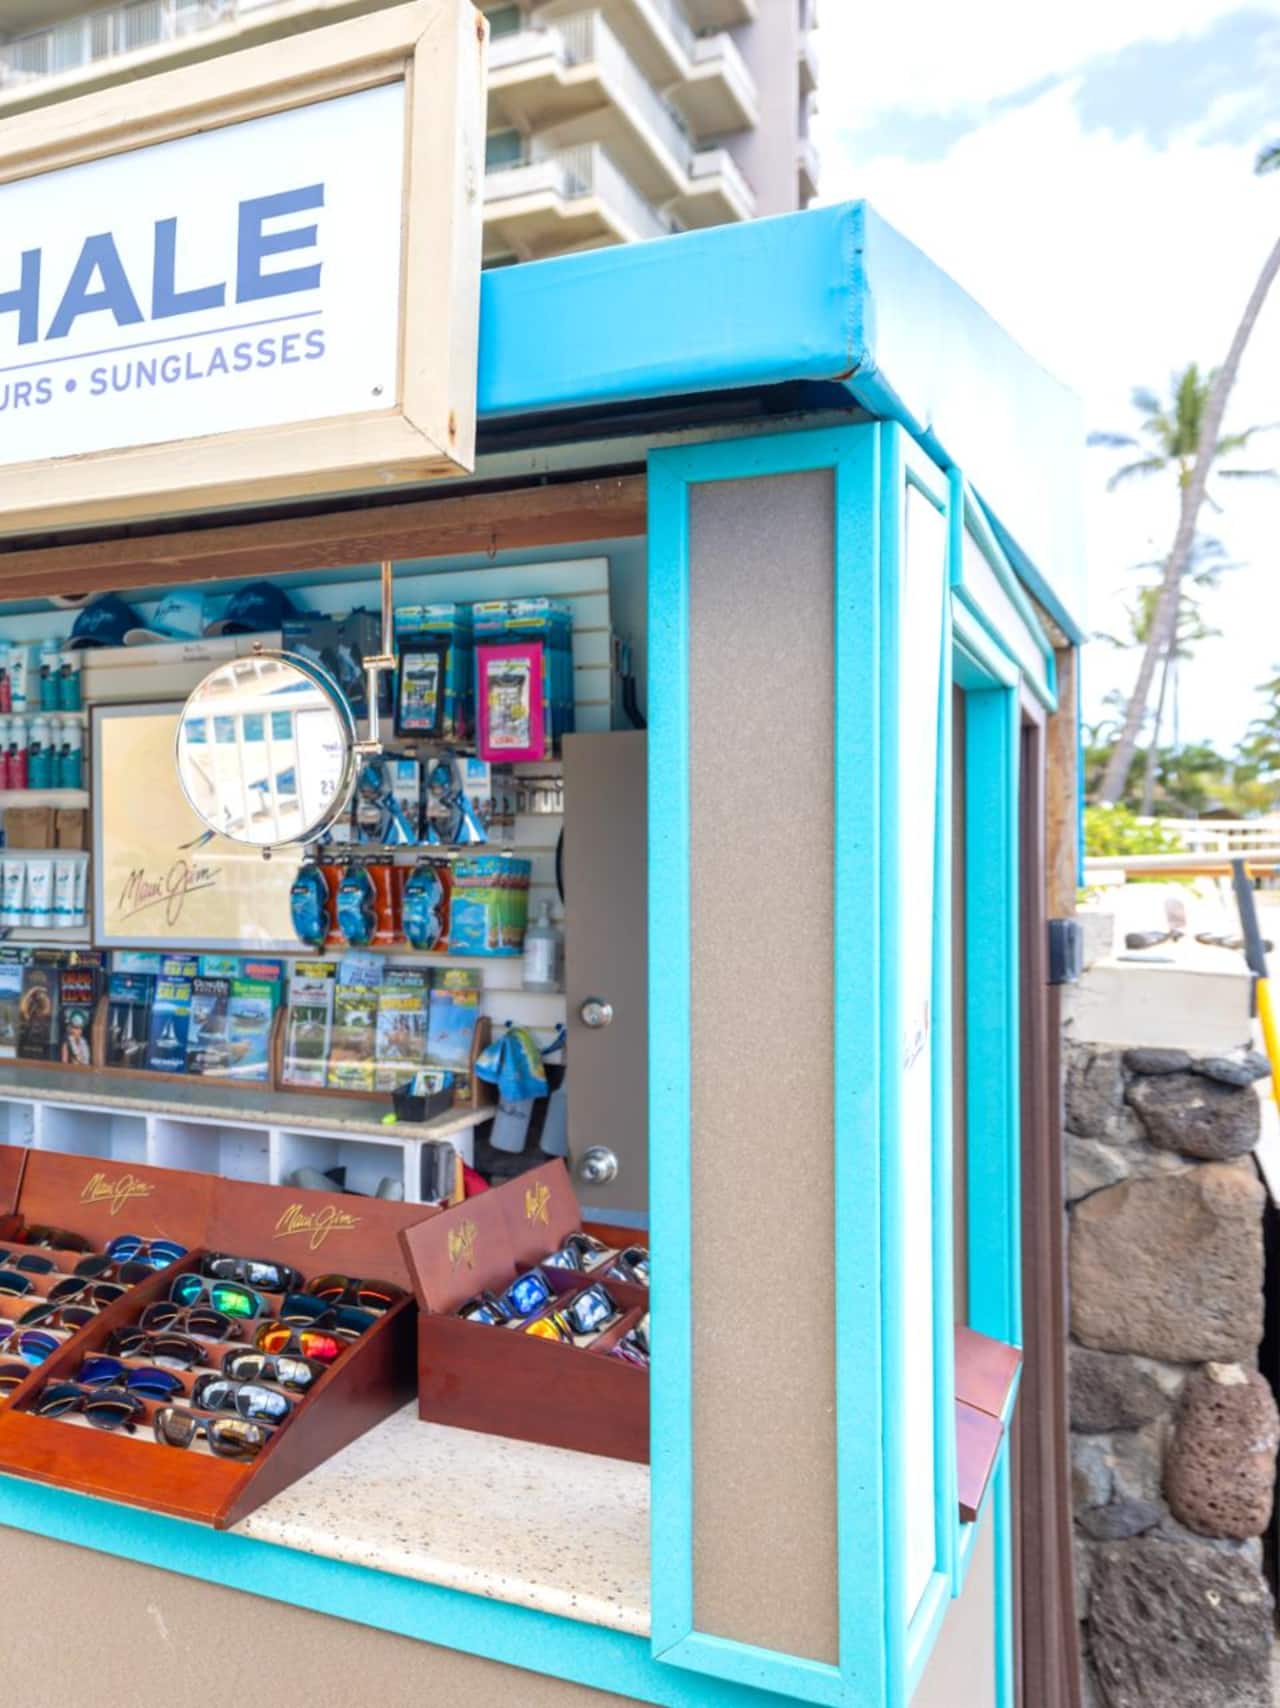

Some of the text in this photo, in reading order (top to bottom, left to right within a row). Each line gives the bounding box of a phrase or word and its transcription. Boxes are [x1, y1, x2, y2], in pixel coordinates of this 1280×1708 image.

[89, 329, 326, 396] SUNGLASSES
[118, 859, 222, 927] Maui Jim
